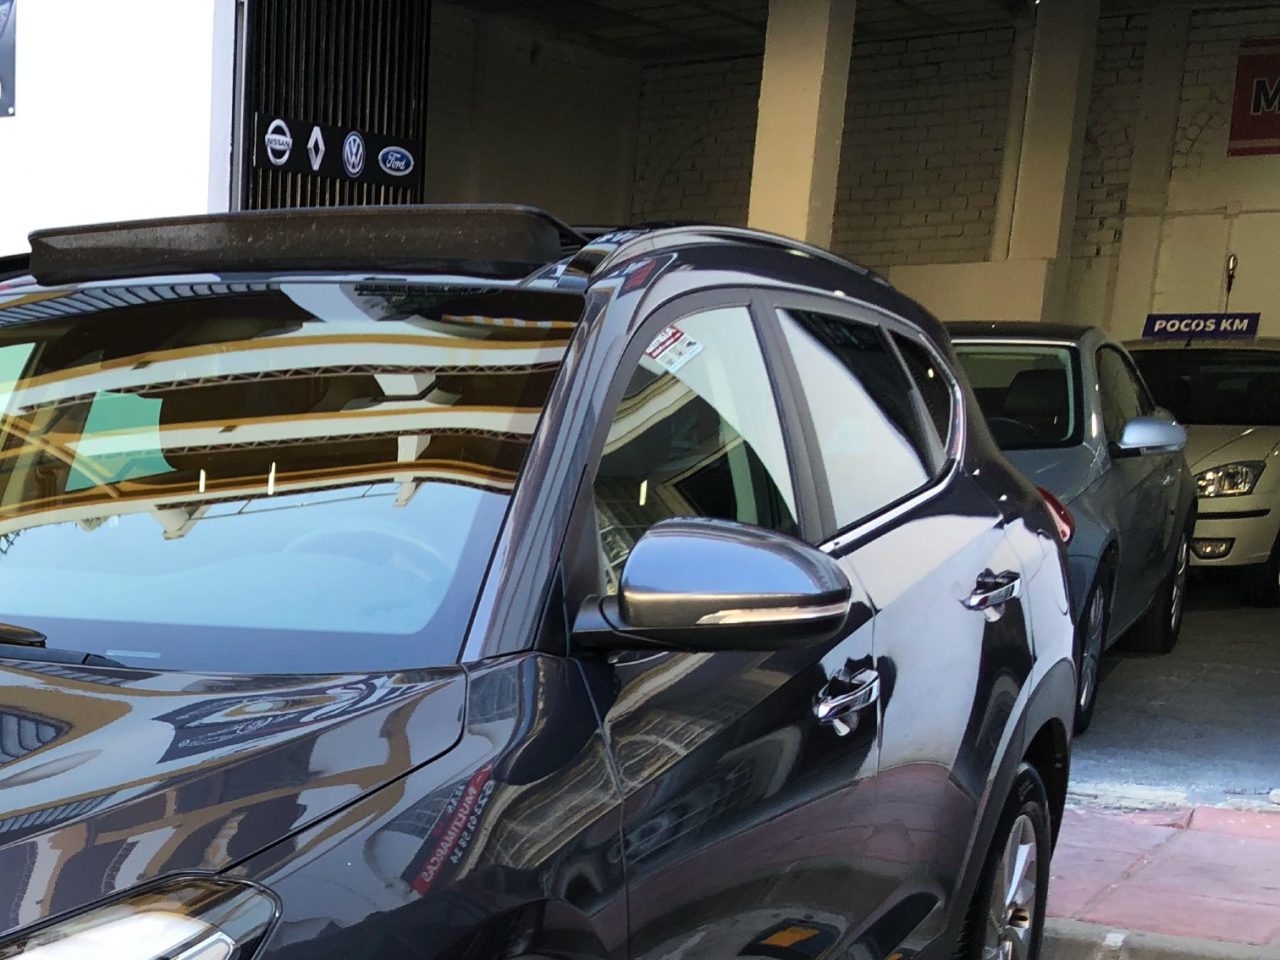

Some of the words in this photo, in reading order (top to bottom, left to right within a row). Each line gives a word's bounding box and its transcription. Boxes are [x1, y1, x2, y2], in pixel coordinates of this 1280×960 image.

[266, 137, 291, 150] NISSAN
[386, 152, 406, 171] Ford
[1154, 319, 1216, 333] POCOS
[1220, 318, 1249, 331] KM
